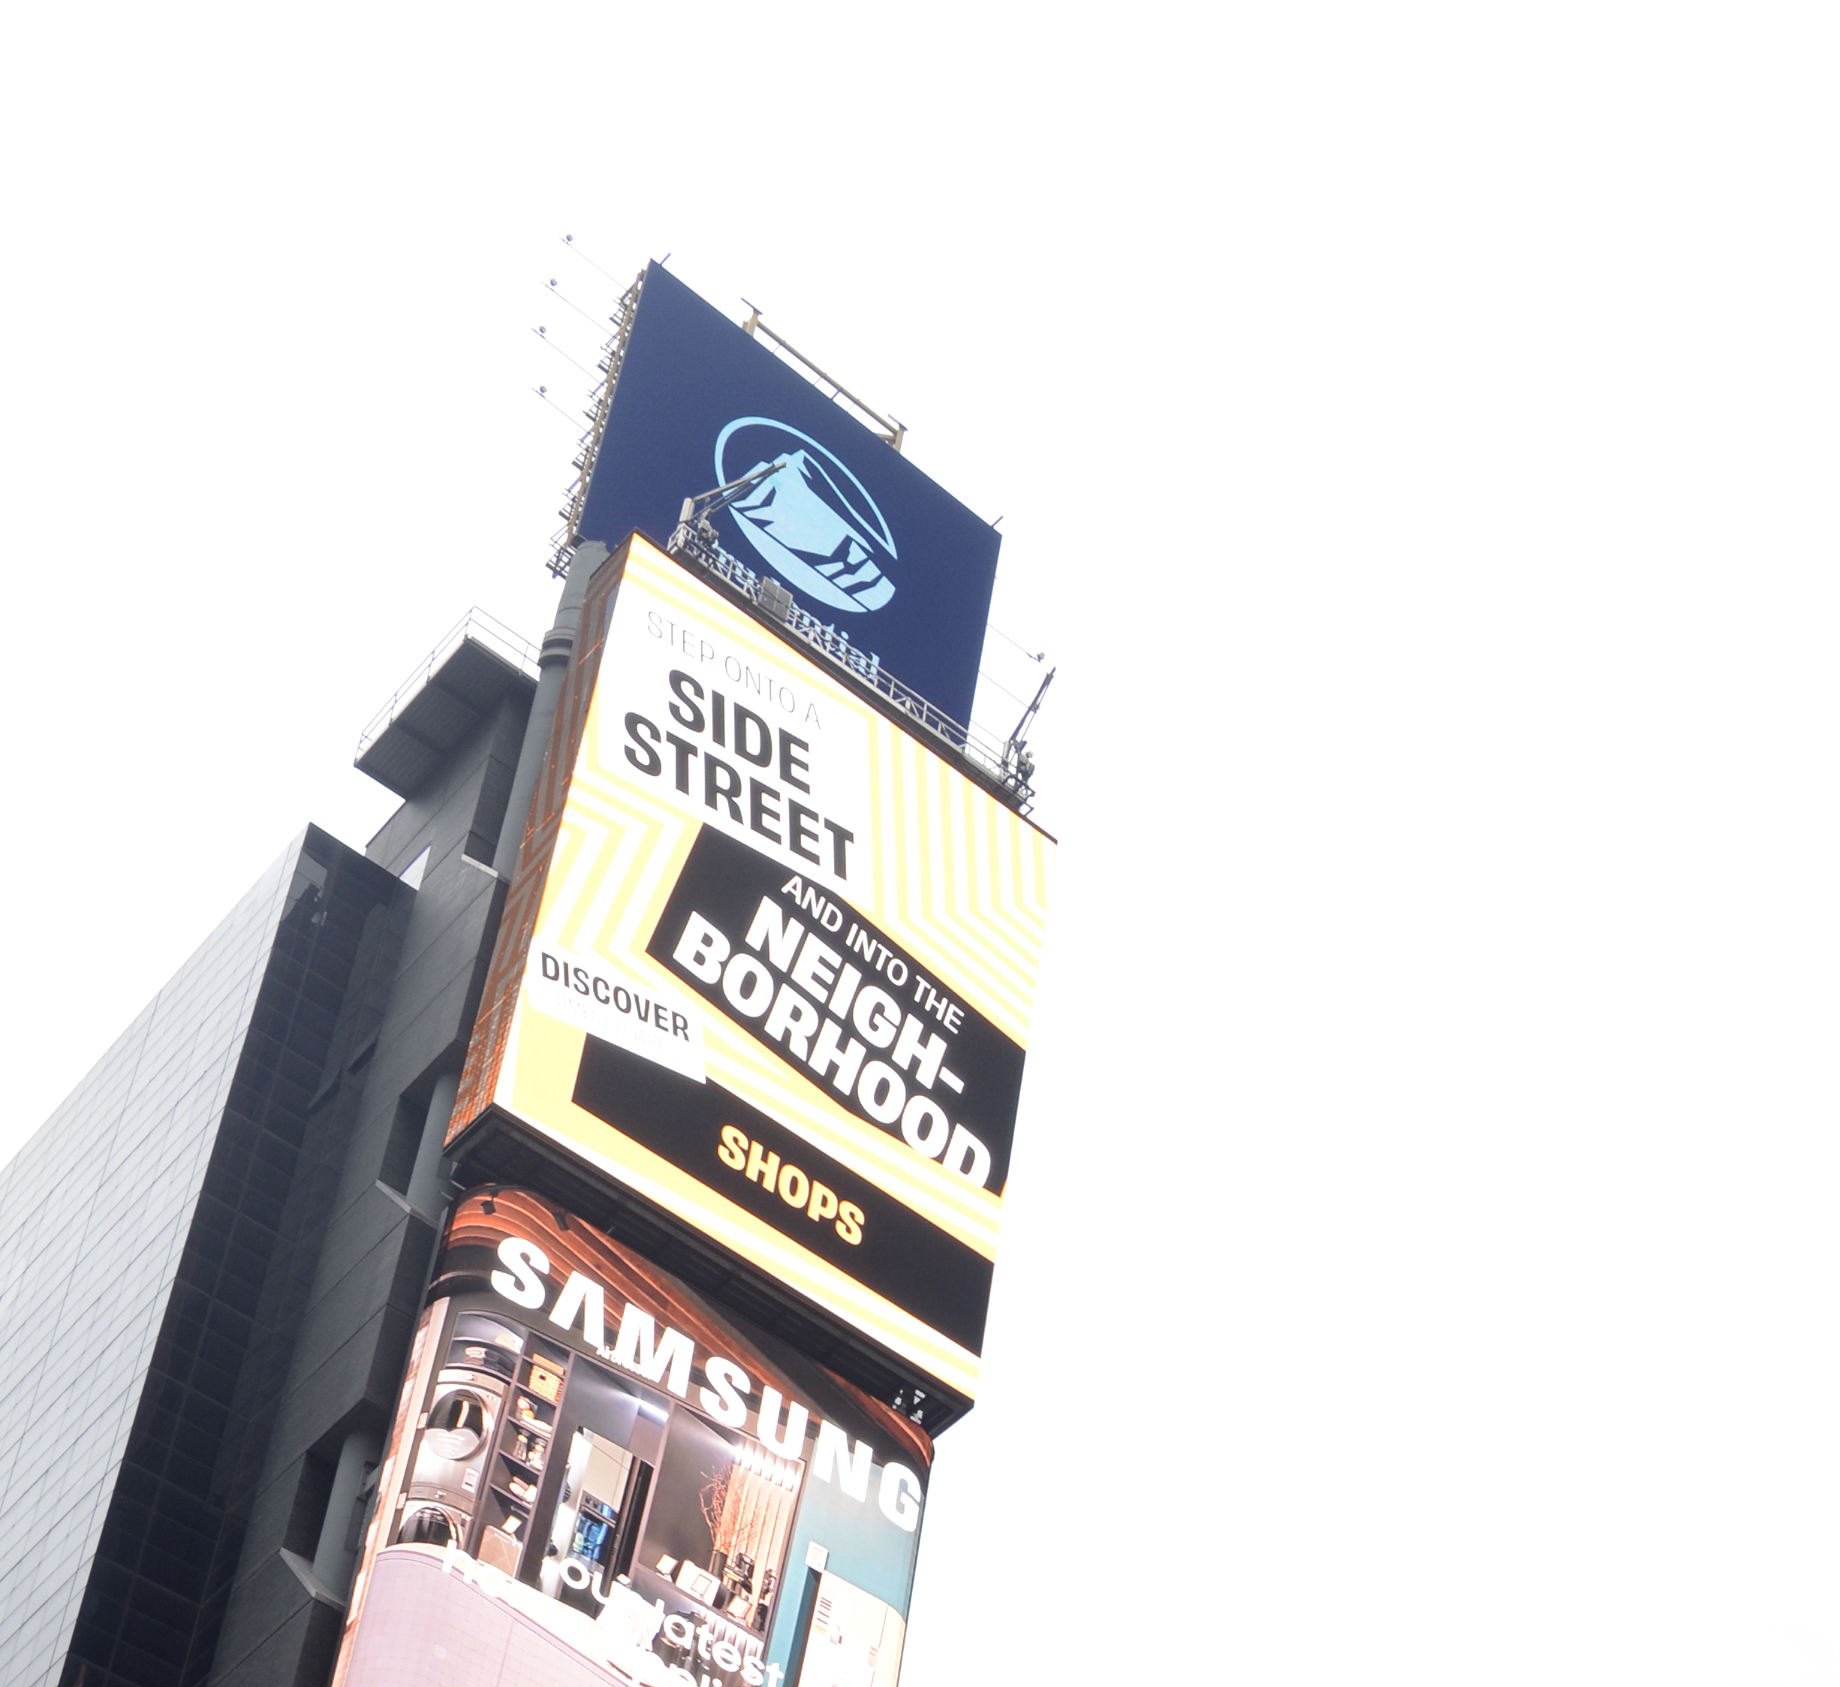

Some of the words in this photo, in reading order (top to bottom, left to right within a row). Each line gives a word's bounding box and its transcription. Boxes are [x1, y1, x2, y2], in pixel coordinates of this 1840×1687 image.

[647, 611, 715, 663] STEP
[724, 655, 796, 713] ONTO
[804, 702, 822, 730] A
[668, 669, 811, 796] SIDE
[624, 711, 855, 881] STREET
[541, 951, 690, 1043] DISCOVER
[744, 895, 965, 1094] NEIGH-
[780, 874, 844, 933] AND
[847, 922, 909, 987] INTO
[915, 974, 965, 1036] THE
[672, 910, 992, 1189] BORHOOD
[717, 1124, 866, 1246] SHOPS
[490, 1236, 924, 1533] SAMSUNG
